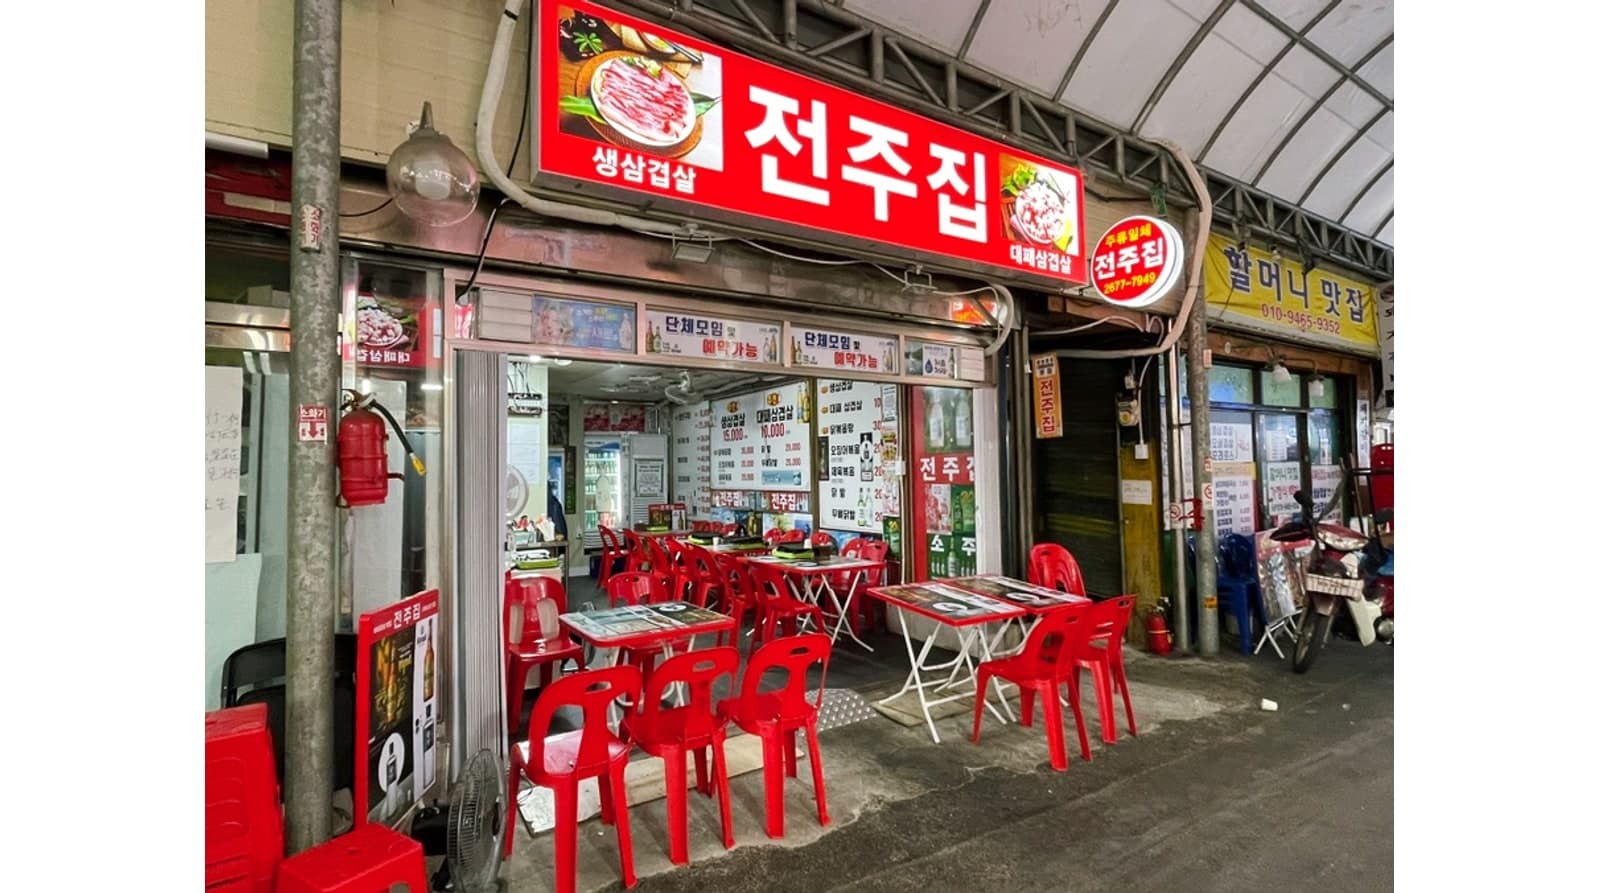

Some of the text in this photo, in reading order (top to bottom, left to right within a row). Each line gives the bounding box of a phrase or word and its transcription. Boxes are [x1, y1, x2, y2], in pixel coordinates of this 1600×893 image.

[592, 145, 696, 194] 생삼겹살
[744, 83, 988, 244] 전주집
[1105, 223, 1152, 248] 주류일체
[1009, 244, 1072, 277] 대패삼겹살
[1095, 237, 1164, 280] 전주집
[1104, 272, 1156, 294] 2677-7949
[1224, 247, 1364, 323] 할머니 맛집
[666, 315, 723, 336] 단체모임
[1262, 303, 1341, 334] 010-9465-9352
[702, 338, 758, 360] 예약가능
[804, 331, 850, 350] 단체모임
[834, 351, 879, 369] 예약가능
[300, 407, 327, 418] 소화기
[1040, 380, 1055, 433] 전주집
[771, 493, 796, 511] 전주집
[394, 603, 421, 629] 전주집
